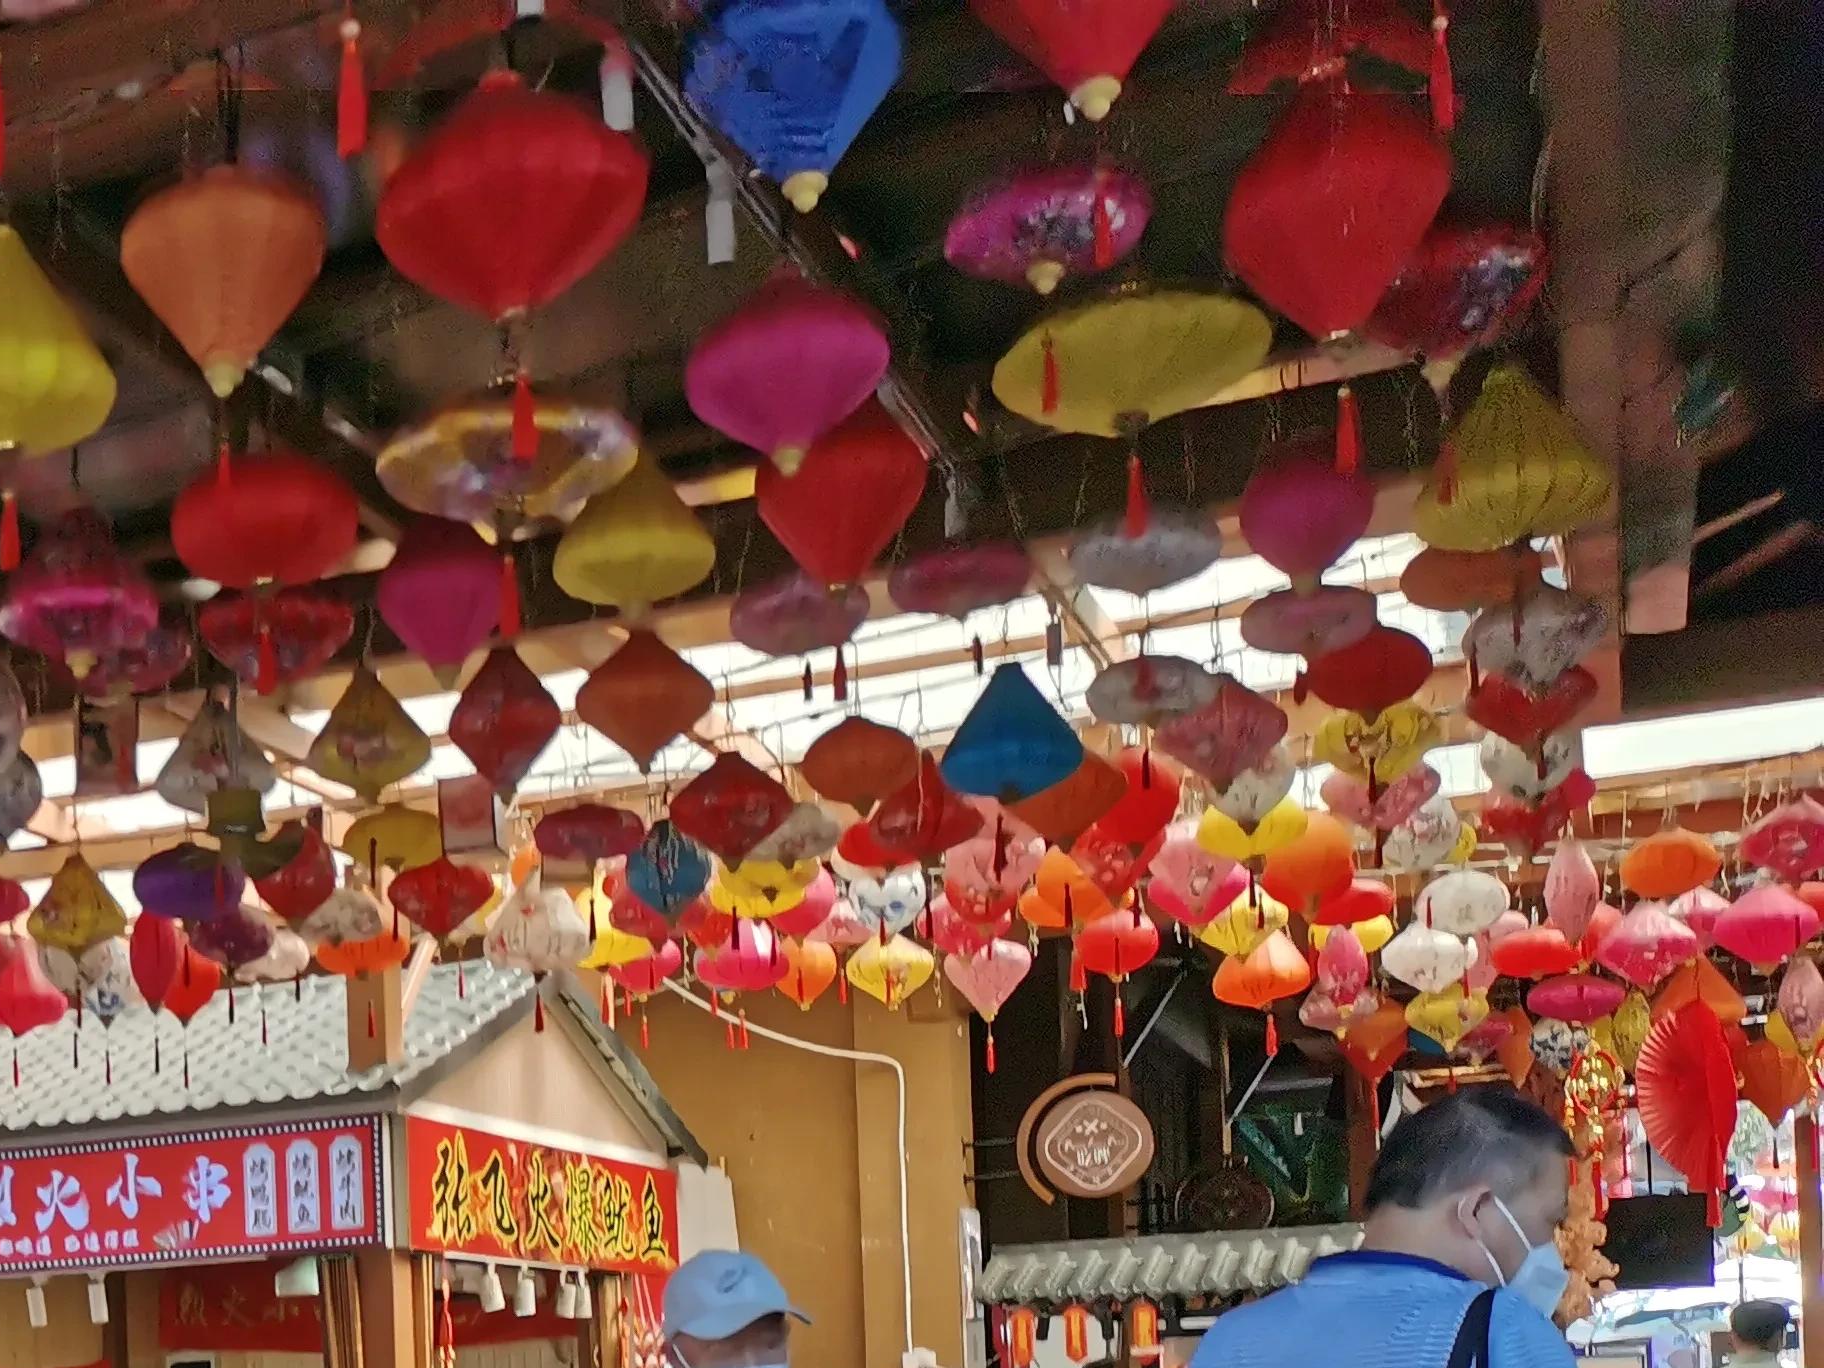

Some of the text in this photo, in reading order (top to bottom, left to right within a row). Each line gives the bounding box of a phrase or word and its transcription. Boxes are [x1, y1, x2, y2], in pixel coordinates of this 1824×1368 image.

[433, 1131, 668, 1262] 张飞火爆鱿鱼
